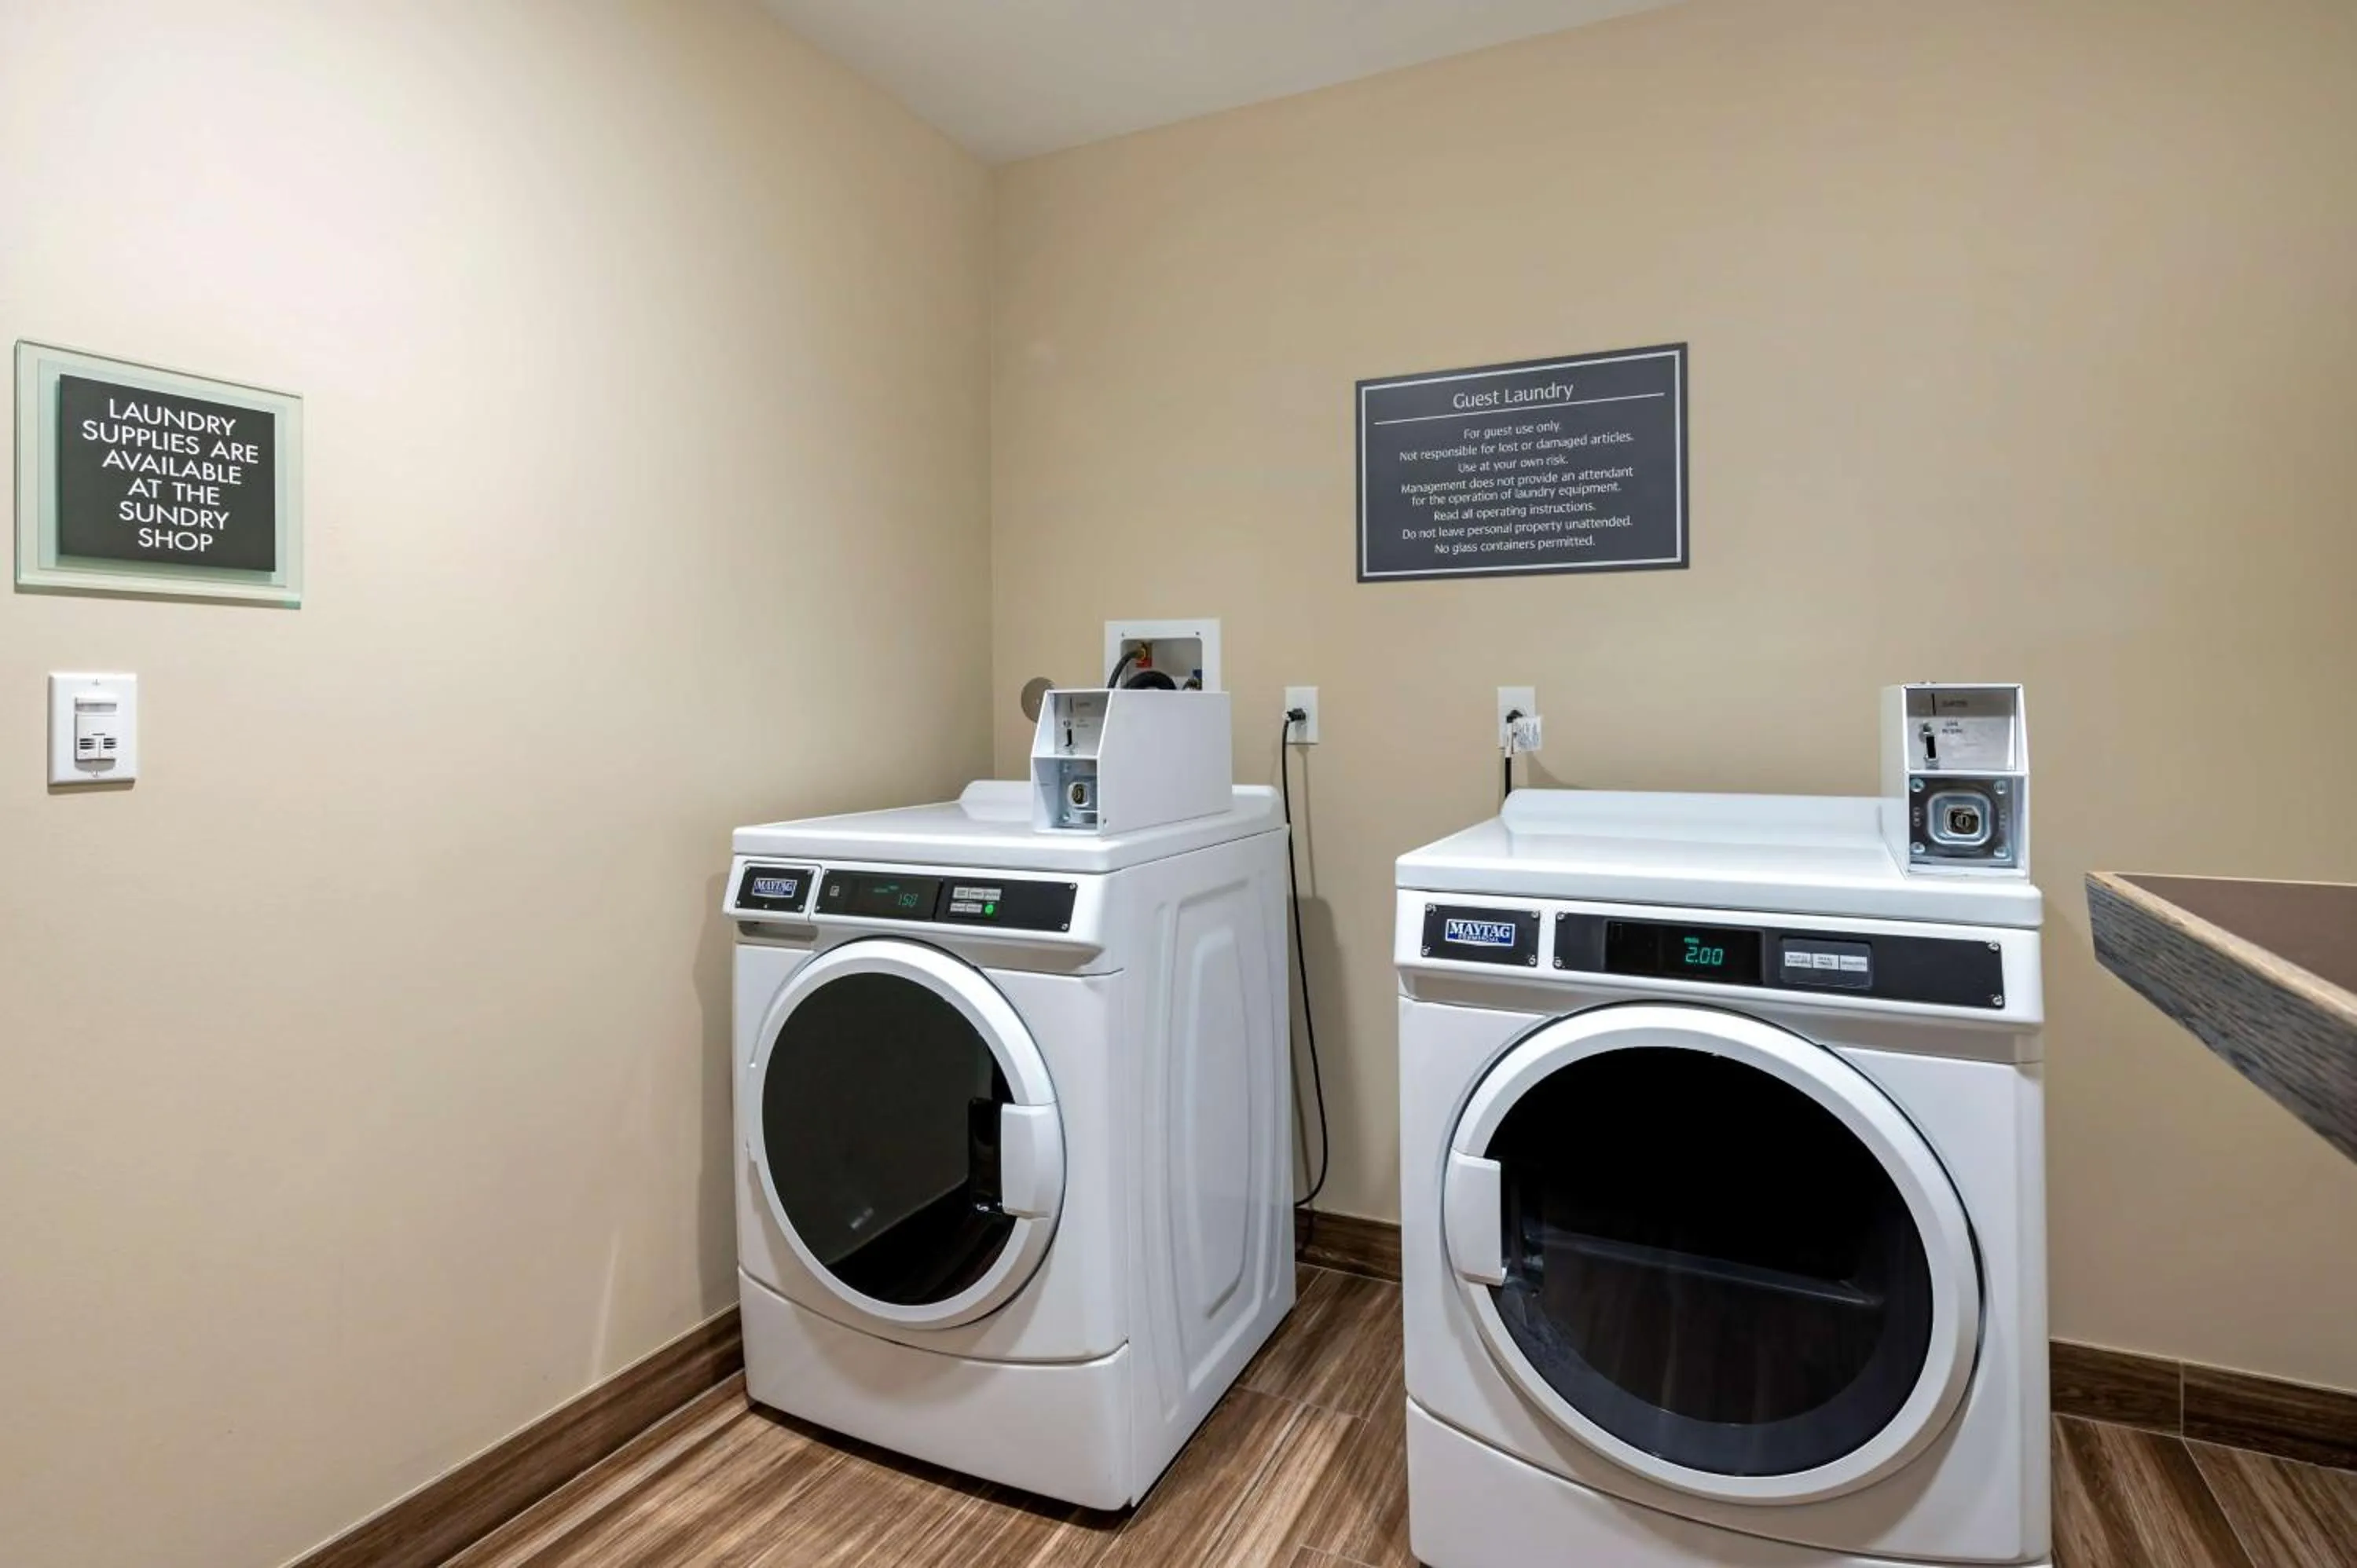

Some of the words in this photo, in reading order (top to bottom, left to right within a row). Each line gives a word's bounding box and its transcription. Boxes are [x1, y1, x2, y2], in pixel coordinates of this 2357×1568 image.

[1453, 391, 1500, 409] Guest
[1505, 382, 1574, 403] Laundry
[109, 398, 236, 436] LAUNDRY
[82, 419, 200, 455] SUPPLIES
[211, 441, 258, 463] ARE
[1464, 428, 1480, 439] For
[1484, 427, 1512, 441] guest
[1516, 425, 1534, 434] use
[1536, 420, 1562, 433] only.
[1399, 451, 1417, 461] Not
[1420, 445, 1477, 461] responsible
[1481, 444, 1496, 453] for
[1498, 441, 1519, 452] lost
[1522, 441, 1532, 451] or
[1537, 434, 1588, 449] damaged
[1590, 432, 1634, 445] articles.
[101, 449, 242, 485] AVAILABLE
[1457, 462, 1477, 473] Use
[1479, 461, 1490, 471] at
[1494, 460, 1516, 471] your
[1520, 458, 1543, 467] own
[1546, 455, 1569, 466] risk.
[128, 478, 163, 499] AT
[172, 482, 220, 505] THE
[1401, 480, 1467, 496] Management
[1469, 478, 1494, 489] does
[1497, 476, 1515, 486] not
[1518, 471, 1558, 487] provide
[1561, 472, 1575, 482] an
[1578, 467, 1633, 480] attendant
[1412, 496, 1427, 507] for
[1429, 494, 1446, 505] the
[1449, 490, 1497, 505] operation
[1501, 488, 1512, 500] of
[1515, 482, 1556, 499] laundry
[1559, 482, 1622, 497] equipment.
[119, 500, 229, 530] SUNDRY
[1434, 510, 1459, 522] Read
[1461, 508, 1474, 519] all
[1476, 504, 1527, 520] operating
[1530, 500, 1596, 514] instructions.
[138, 528, 213, 551] SHOP
[1402, 528, 1417, 540] Do
[1419, 527, 1436, 537] not
[1439, 526, 1464, 537] leave
[1468, 520, 1512, 537] personal
[1515, 520, 1563, 535] property
[1565, 515, 1633, 529] unattended.
[1434, 543, 1450, 554] No
[1452, 540, 1478, 555] glass
[1480, 537, 1535, 551] containers
[1538, 534, 1596, 549] permitted.
[754, 879, 794, 892] MAYTAG
[1450, 921, 1510, 938] MAYTAG
[1685, 947, 1723, 965] 2.00
